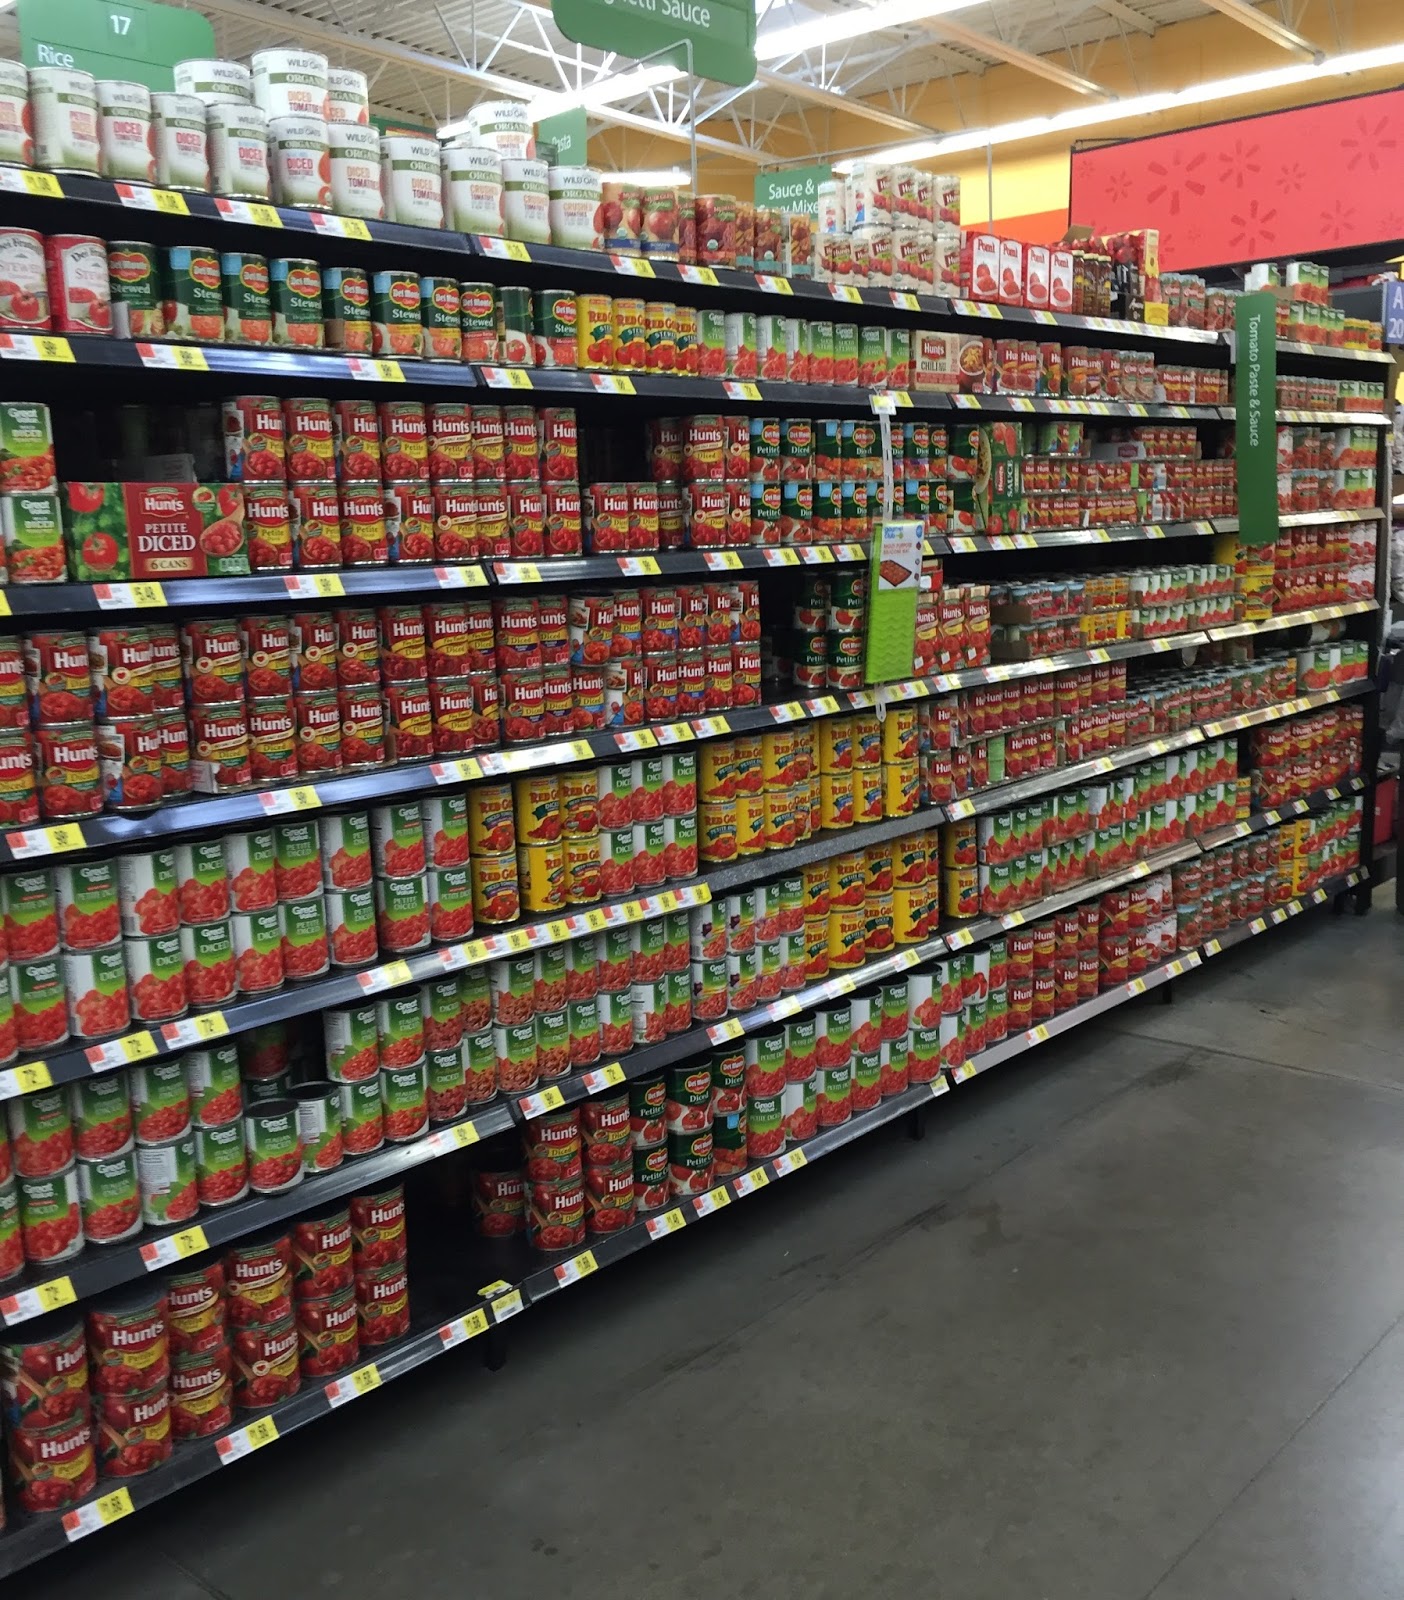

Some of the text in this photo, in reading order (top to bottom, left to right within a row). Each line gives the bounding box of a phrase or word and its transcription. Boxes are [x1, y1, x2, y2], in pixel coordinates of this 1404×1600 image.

[662, 0, 710, 28] Sauce
[110, 15, 131, 35] 17
[37, 44, 74, 68] Rice
[769, 178, 814, 200] Sauce &
[463, 317, 494, 327] Stewed
[1249, 314, 1261, 447] Tomato Paste & Sauce
[791, 445, 810, 454] Diced
[21, 500, 51, 510] Great
[145, 523, 188, 534] PETITE
[356, 525, 378, 534] Petite
[138, 535, 196, 552] DICED
[151, 560, 188, 569] 6 CANS
[511, 635, 531, 644] Diced
[446, 645, 464, 654] Diced
[550, 701, 568, 709] Diced
[583, 696, 602, 705] Diced
[263, 743, 286, 752] Diced
[529, 791, 548, 803] RED
[562, 786, 579, 798] RED
[769, 804, 784, 817] RED
[705, 813, 722, 826] RED
[282, 826, 308, 839] Great
[568, 851, 585, 864] RED
[80, 866, 109, 879] Great
[480, 870, 499, 882] RED
[836, 864, 853, 876] RED
[444, 871, 466, 884] Great
[390, 881, 414, 894] Great
[393, 901, 418, 911] DICED
[394, 896, 417, 904] PETITE
[292, 904, 317, 916] Great
[200, 926, 225, 938] Great
[840, 922, 856, 934] RED
[199, 940, 230, 953] DICED
[26, 963, 55, 976] Great
[395, 1001, 418, 1013] Great
[576, 1001, 595, 1013] Great
[543, 1013, 564, 1025] Great
[513, 1026, 533, 1038] Great
[434, 1054, 457, 1065] Great
[392, 1075, 416, 1086] Great
[436, 1073, 460, 1082] DICED
[689, 1091, 709, 1103] Diced
[640, 1106, 659, 1116] Petite
[754, 1101, 775, 1111] Great
[260, 1118, 288, 1130] Great
[210, 1129, 237, 1141] Great
[548, 1147, 571, 1157] Diced
[686, 1156, 706, 1167] Petite
[96, 1162, 126, 1175] Great
[642, 1172, 661, 1182] Petite
[22, 1184, 54, 1199] Great
[562, 1212, 582, 1224] Diced
